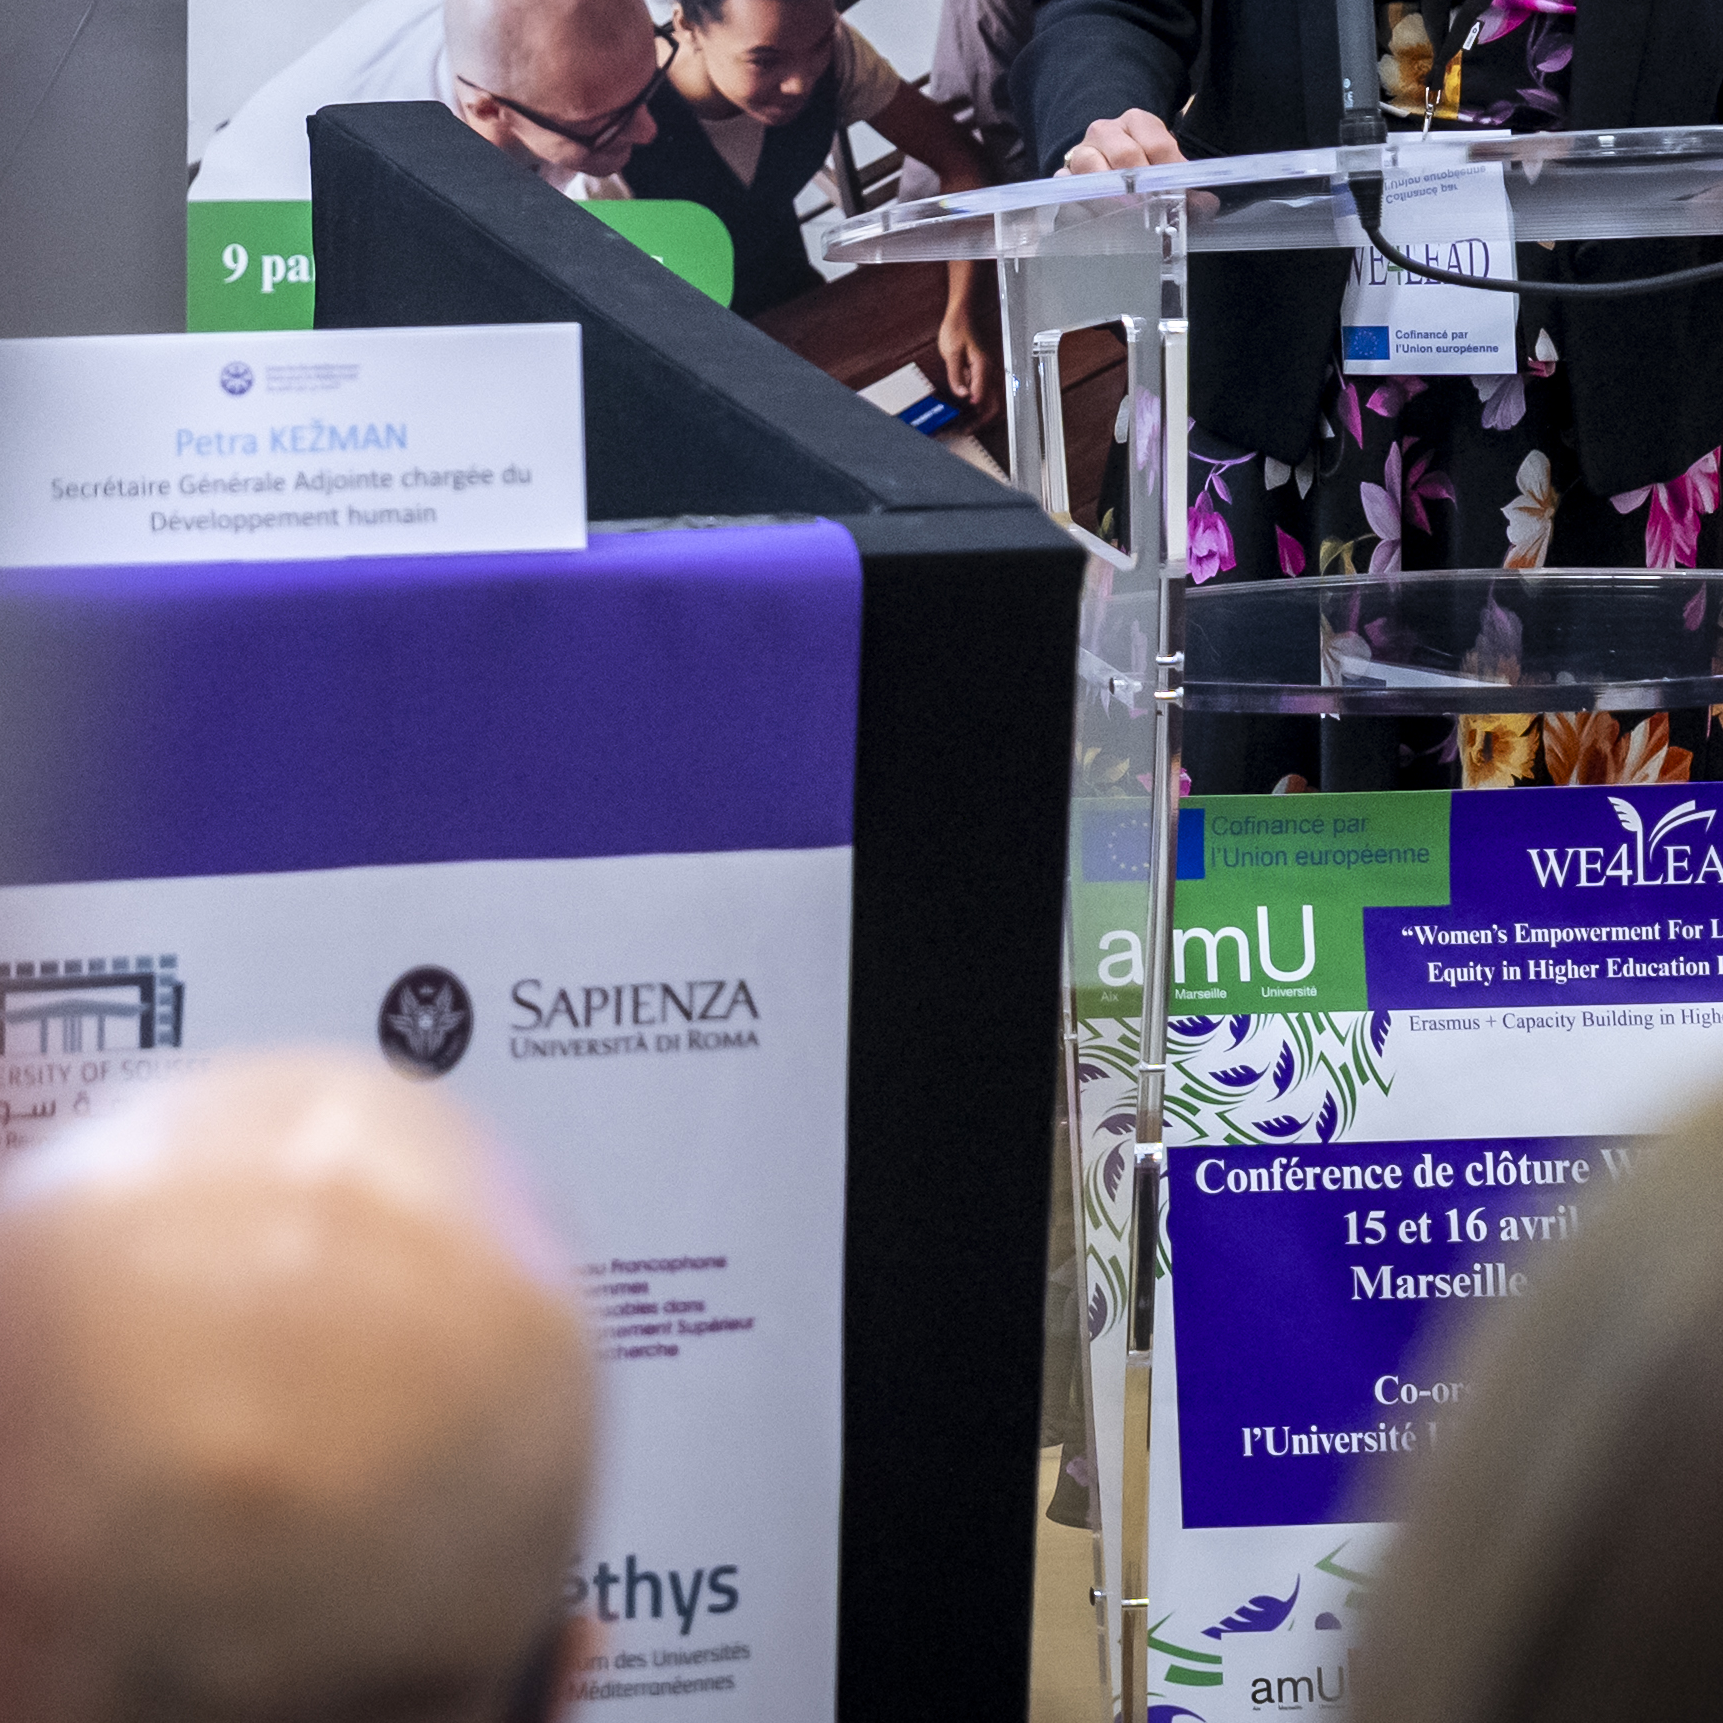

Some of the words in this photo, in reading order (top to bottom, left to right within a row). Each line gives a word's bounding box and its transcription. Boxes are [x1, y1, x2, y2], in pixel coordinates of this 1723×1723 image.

[222, 243, 248, 284] 9
[1395, 330, 1447, 340] Cofinancé
[1452, 330, 1468, 343] par
[1436, 343, 1499, 355] européenne
[176, 428, 258, 457] Petra
[270, 419, 408, 453] KEŽMAN
[51, 475, 171, 500] Secrétaire
[179, 469, 285, 497] Générale
[294, 467, 392, 496] Adjointe
[401, 463, 494, 491] chargée
[502, 462, 532, 485] du
[151, 506, 339, 535] Développement
[348, 503, 437, 527] humain
[1211, 815, 1324, 837] Cofinancé
[1332, 816, 1367, 839] par
[1295, 845, 1430, 867] européenne
[1098, 905, 1316, 987] amU
[1401, 924, 1508, 946] “Women’s
[1514, 922, 1661, 948] Empowerment
[1668, 920, 1704, 941] For
[1428, 962, 1495, 987] Equity
[1502, 960, 1522, 980] in
[1528, 959, 1600, 984] Higher
[1606, 957, 1710, 978] Education
[510, 978, 760, 1031] SAPIENZA
[1100, 990, 1119, 1002] Aix
[1174, 988, 1227, 1000] Marseille
[1261, 985, 1317, 998] Université
[1409, 1013, 1480, 1032] Erasmus
[1485, 1017, 1497, 1029] +
[1502, 1010, 1576, 1034] Capacity
[1582, 1008, 1654, 1031] Building
[1660, 1007, 1675, 1025] in
[82, 1060, 109, 1084] OF
[1195, 1157, 1402, 1194] Conférence
[1413, 1153, 1454, 1188] de
[1465, 1150, 1590, 1187] clôture
[1344, 1210, 1386, 1245] 15
[1398, 1212, 1432, 1244] et
[1445, 1207, 1488, 1242] 16
[1351, 1263, 1527, 1301] Marseille
[1242, 1421, 1417, 1457] l’Université
[614, 1650, 647, 1670] des
[652, 1643, 751, 1667] Universités
[1251, 1666, 1344, 1704] amU
